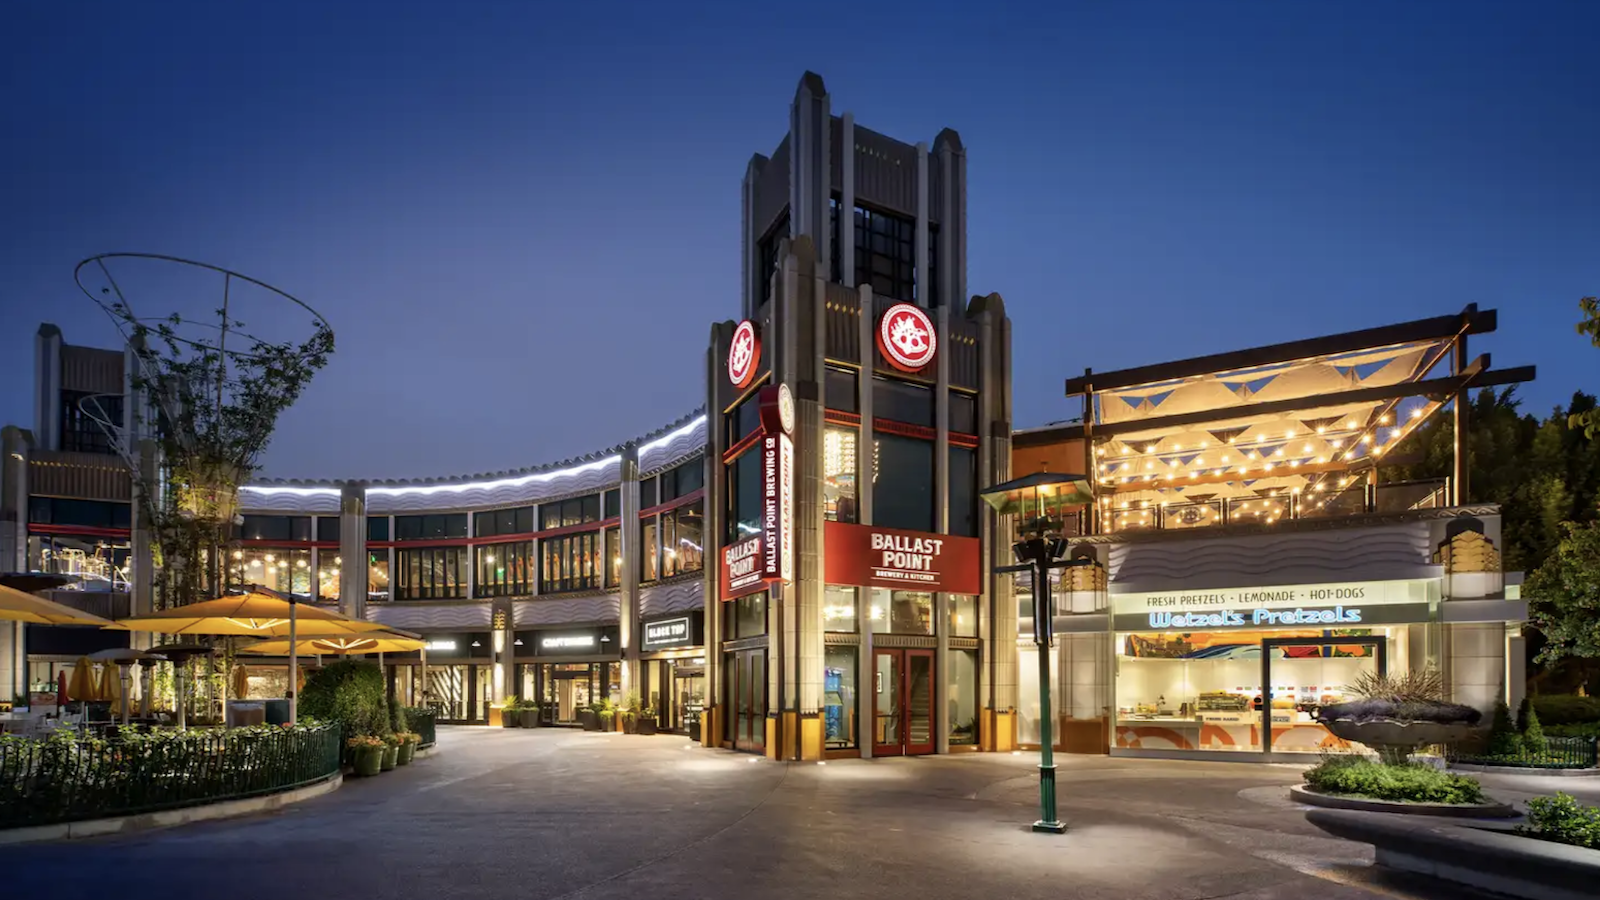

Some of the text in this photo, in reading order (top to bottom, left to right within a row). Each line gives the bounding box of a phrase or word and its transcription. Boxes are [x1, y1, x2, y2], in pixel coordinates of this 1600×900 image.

[765, 450, 776, 497] BREWING
[766, 498, 776, 529] POINT
[725, 537, 760, 566] BALLAST
[766, 530, 776, 573] BALLAST
[871, 533, 943, 556] BALLAST
[730, 555, 755, 579] POINT
[882, 550, 934, 571] POINT
[875, 570, 904, 579] BREWERY
[909, 573, 935, 581] KITCHEN
[1147, 587, 1365, 607] FRESH PRETZELS LEMONADE HOT-DOGS
[1149, 604, 1362, 628] Wetzel's Pretzels
